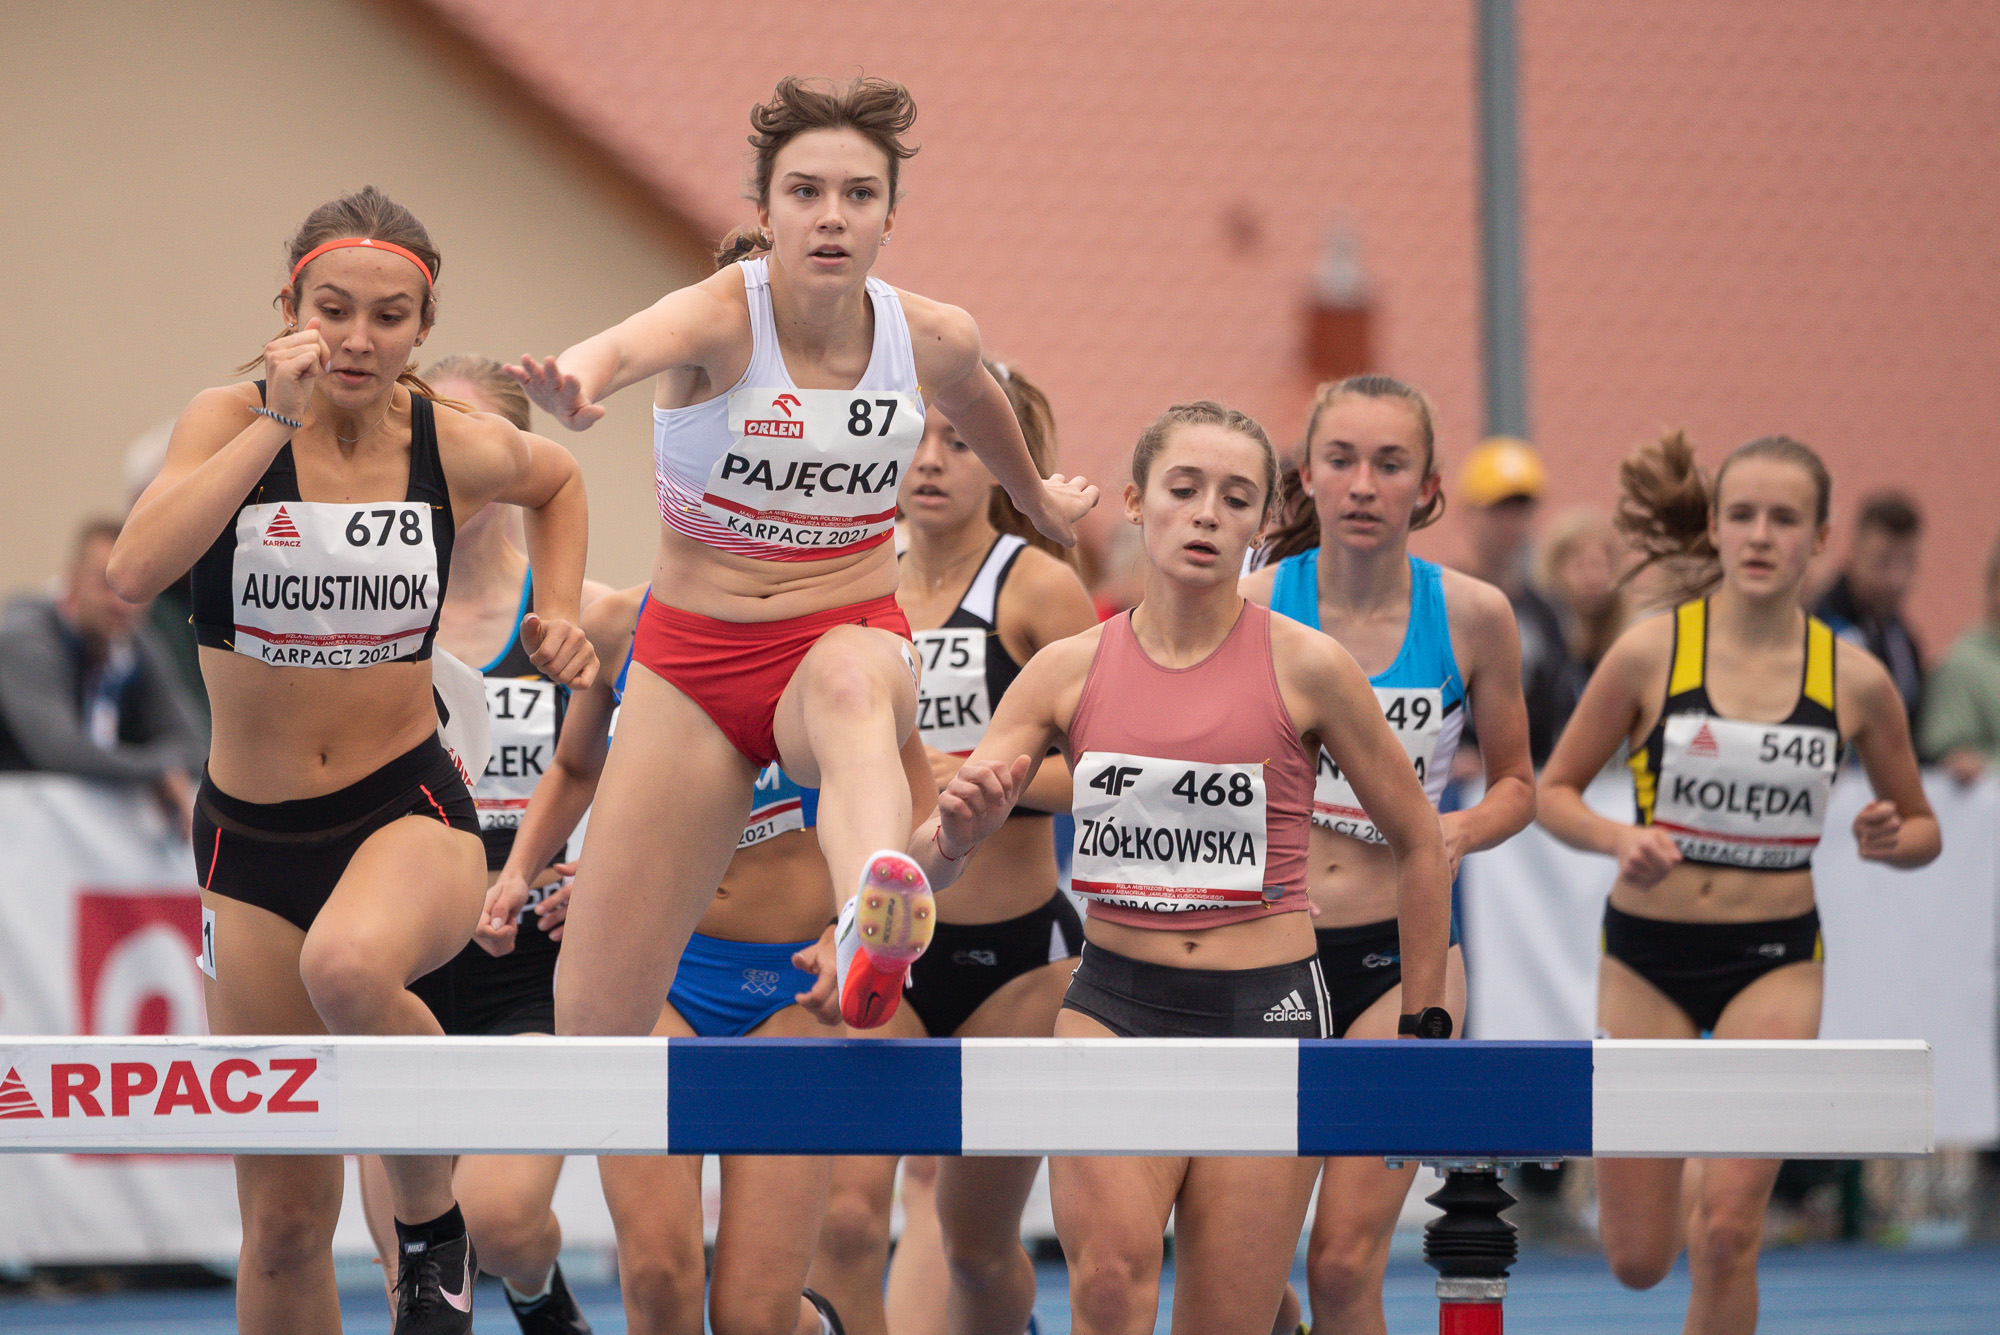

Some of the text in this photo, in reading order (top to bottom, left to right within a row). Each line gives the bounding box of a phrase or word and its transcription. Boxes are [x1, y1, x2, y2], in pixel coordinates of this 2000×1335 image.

[747, 421, 801, 437] ORLEN
[847, 398, 898, 437] 87
[720, 452, 898, 498] PAJĘCKA
[263, 539, 301, 548] KARPACZ
[345, 509, 423, 547] 678
[727, 516, 869, 546] KARPACZ 2021
[241, 573, 428, 611] AUGUSTINIOK
[262, 643, 398, 666] KARPACZ 2021
[912, 637, 970, 671] 75
[484, 686, 542, 719] 17
[918, 690, 982, 730] ŻEK
[1759, 733, 1826, 768] 548
[1089, 765, 1143, 796] 4F
[1172, 770, 1254, 807] 468
[1673, 776, 1812, 822] KOLĘDA
[1078, 816, 1256, 866] ZIÓŁKOWSKA
[204, 921, 213, 968] 1
[1263, 1009, 1312, 1022] adidas
[407, 1243, 425, 1254] NIKE
